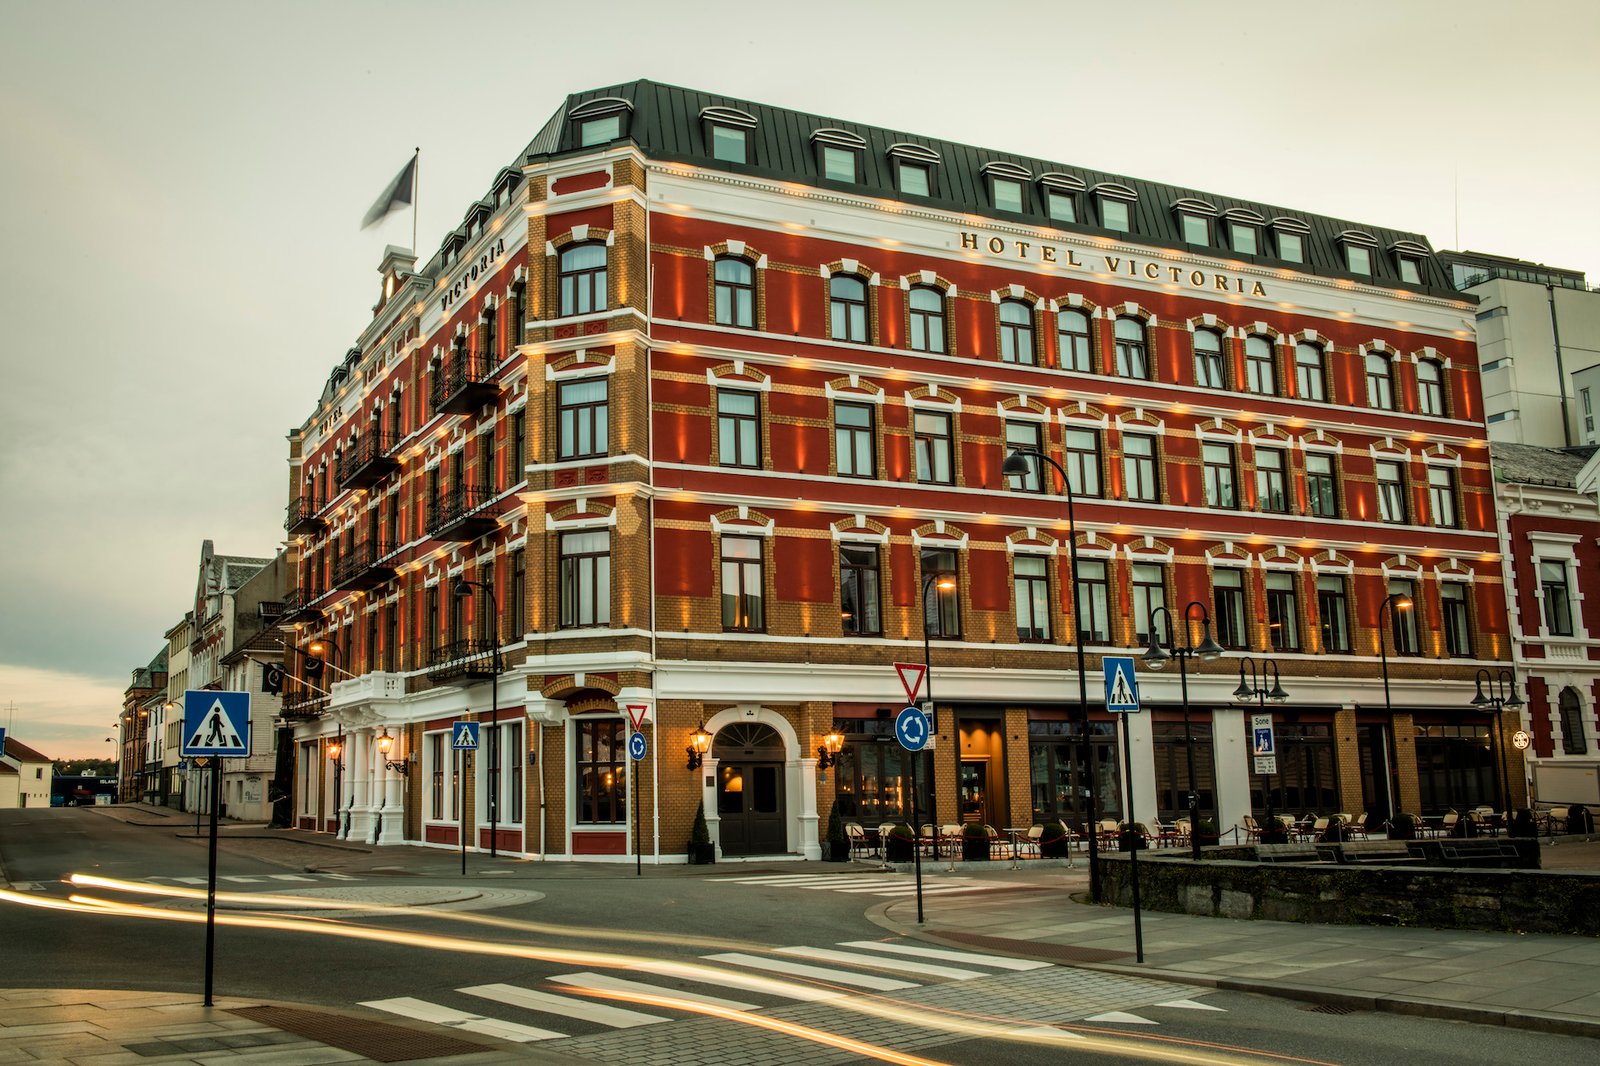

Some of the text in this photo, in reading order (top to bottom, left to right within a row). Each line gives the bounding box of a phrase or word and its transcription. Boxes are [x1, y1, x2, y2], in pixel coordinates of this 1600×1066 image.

[960, 232, 1267, 297] HOTEL VICTORIA
[319, 238, 505, 437] HOTEL VICTORIA
